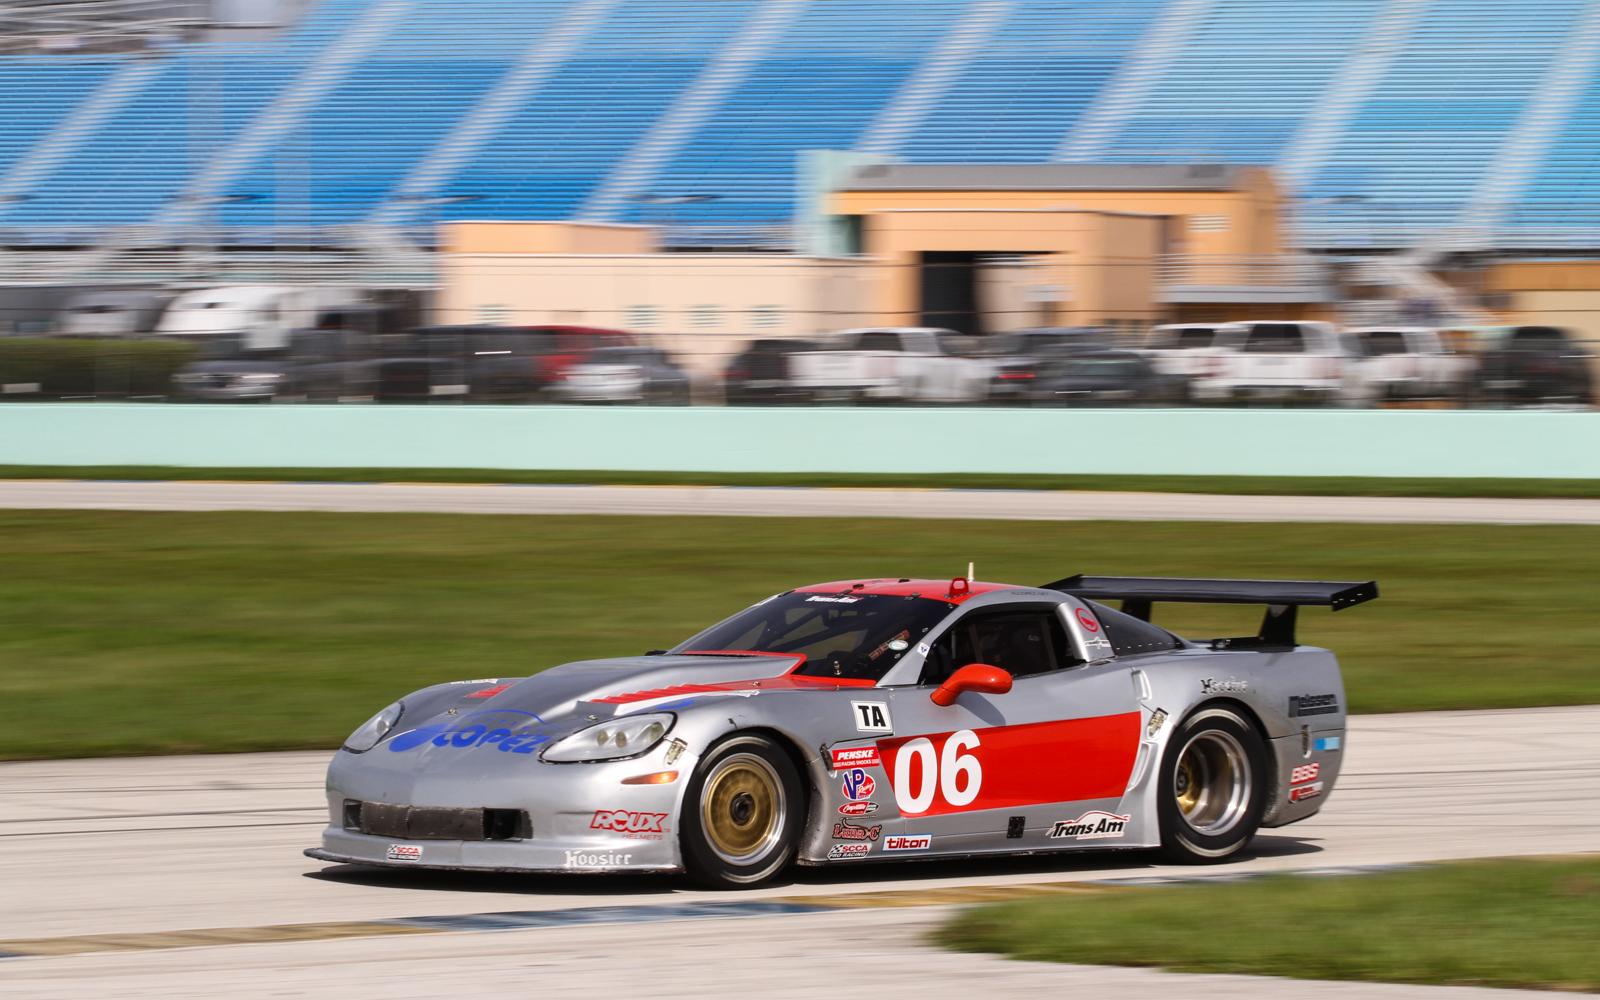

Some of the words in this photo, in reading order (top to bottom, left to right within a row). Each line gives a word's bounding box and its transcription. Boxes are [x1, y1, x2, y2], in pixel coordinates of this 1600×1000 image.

[858, 705, 886, 727] TA
[837, 749, 875, 760] PENSKE
[894, 729, 983, 814] 06
[1290, 762, 1320, 784] BBS
[843, 769, 865, 799] VP
[590, 810, 669, 833] ROUX
[1052, 823, 1095, 837] Trans
[1094, 818, 1124, 833] Am
[622, 833, 663, 841] HELMETS
[886, 838, 929, 850] tilton
[564, 850, 633, 867] Hoosier
